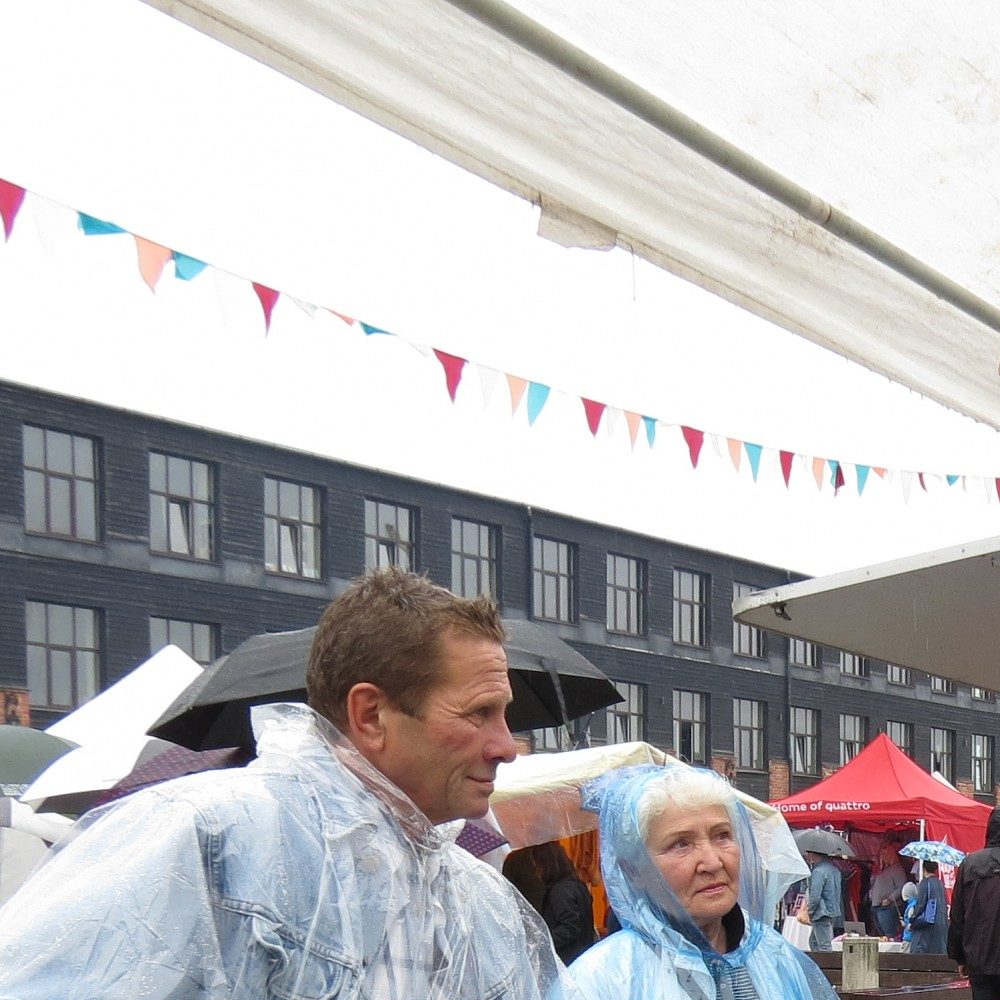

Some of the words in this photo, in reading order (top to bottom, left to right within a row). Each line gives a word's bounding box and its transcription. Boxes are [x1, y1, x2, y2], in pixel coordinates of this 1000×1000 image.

[772, 803, 807, 813] Home
[809, 801, 823, 811] of
[825, 802, 870, 812] quattro
